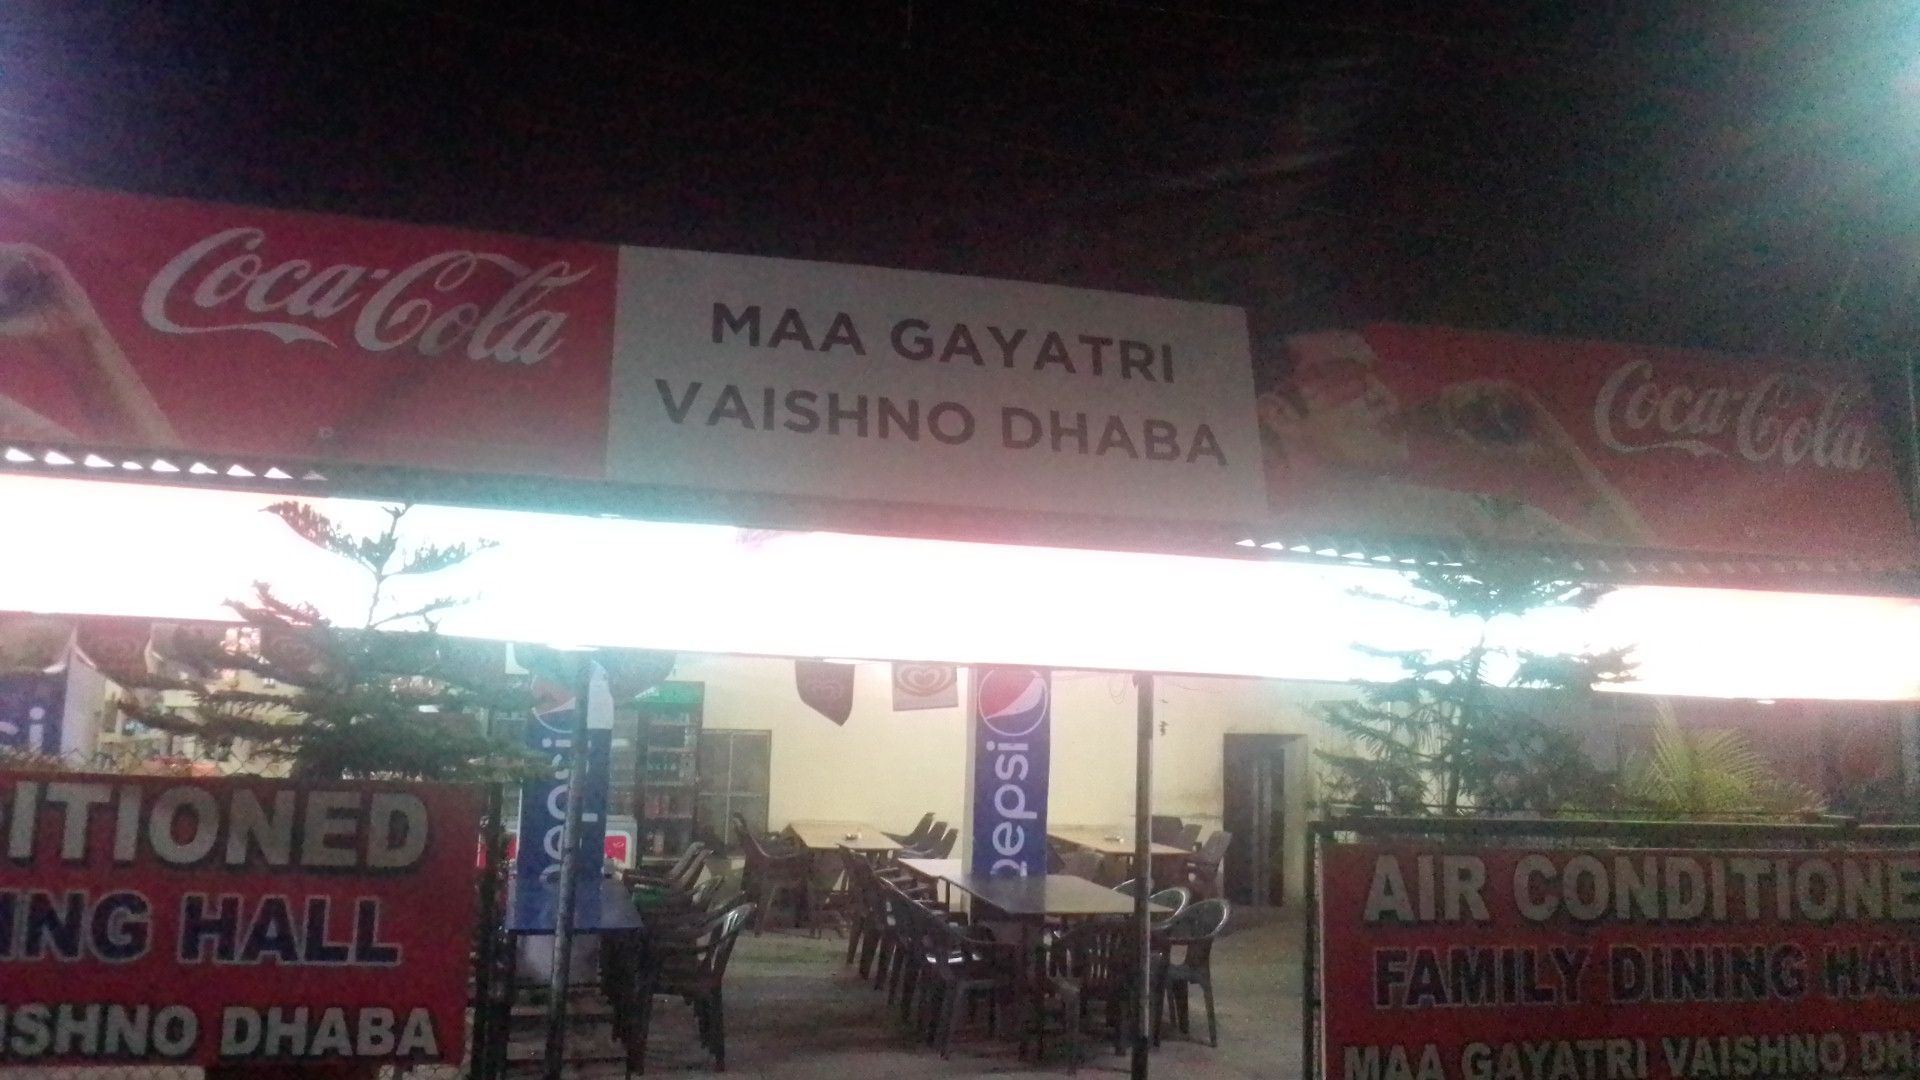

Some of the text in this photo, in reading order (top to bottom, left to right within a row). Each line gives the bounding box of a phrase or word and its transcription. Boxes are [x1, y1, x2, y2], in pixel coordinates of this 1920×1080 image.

[710, 302, 1174, 383] MAA GAYATRI
[655, 379, 1229, 466] VAISHNO DHABA
[8, 781, 429, 870] ITIONED
[1363, 853, 1920, 922] AIR CONDITIONE
[177, 892, 402, 968] HALL
[1373, 944, 1594, 1010] FAMILY
[1608, 942, 1807, 1004] DINING
[220, 1006, 440, 1058] DHABA
[1343, 1043, 1444, 1080] MAA
[1461, 1037, 1647, 1080] GAYATRI
[1661, 1032, 1846, 1078] VAISHNO
